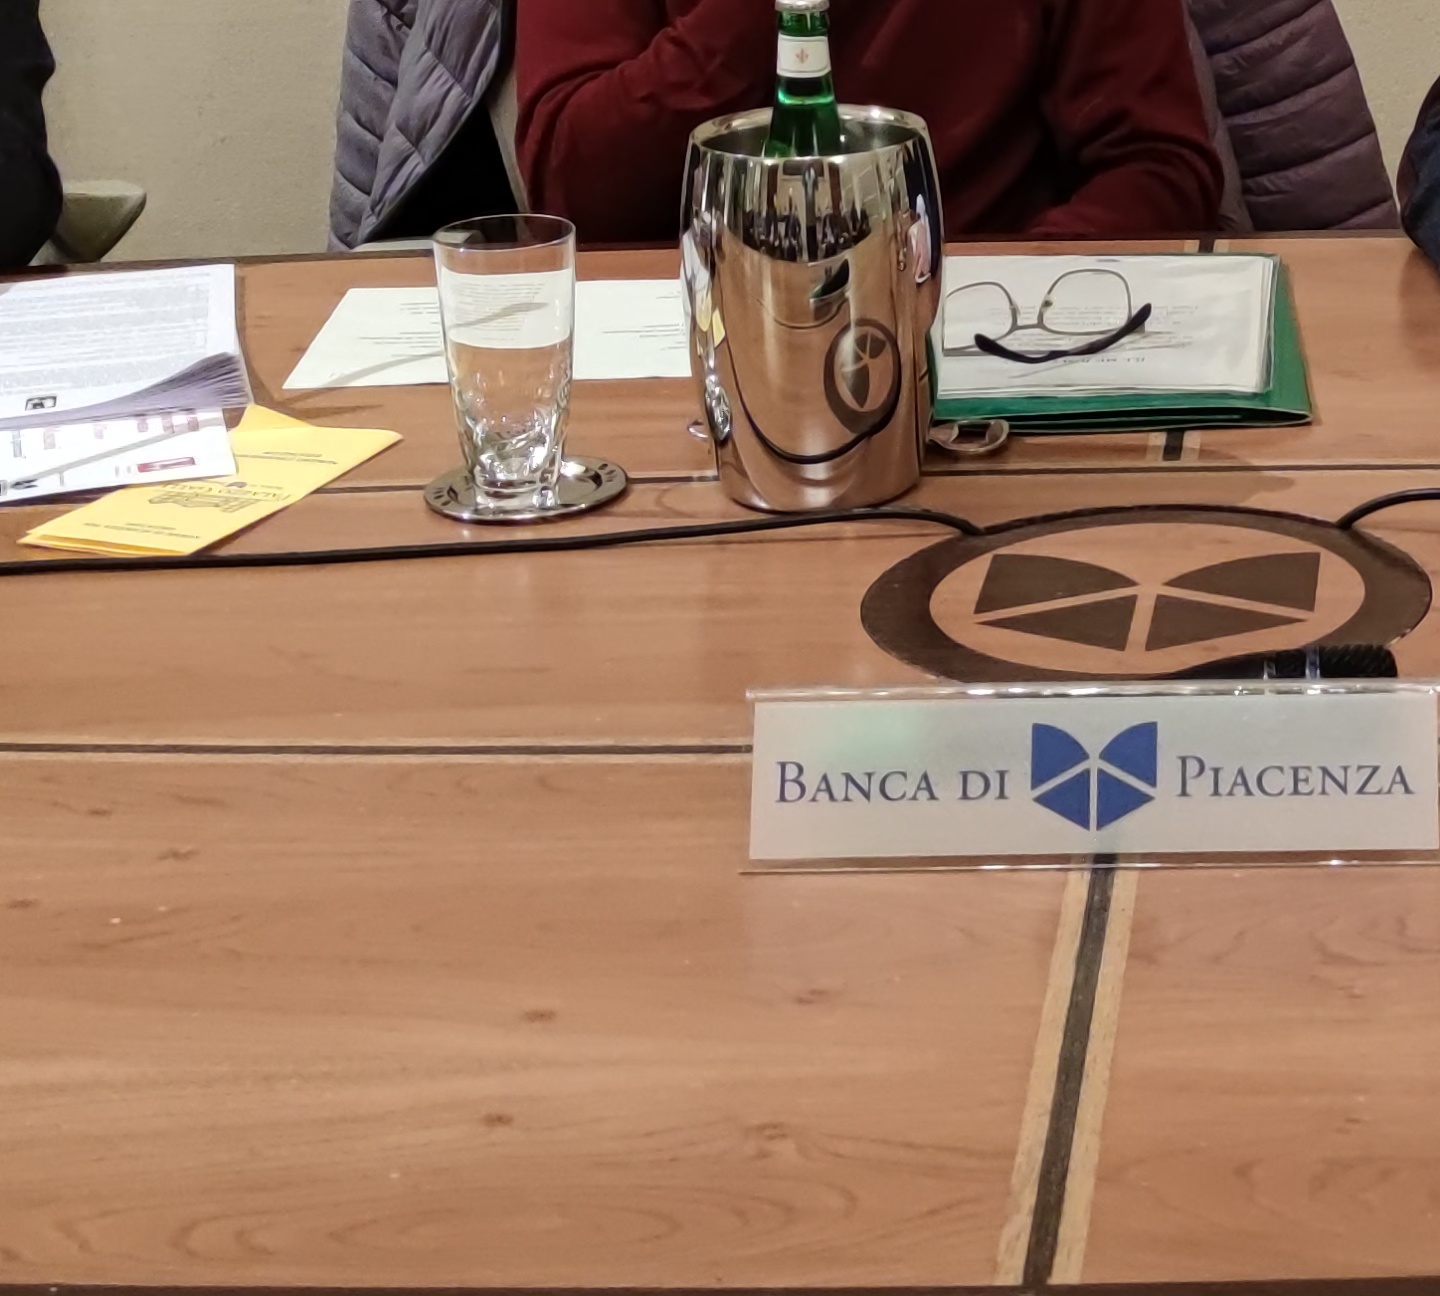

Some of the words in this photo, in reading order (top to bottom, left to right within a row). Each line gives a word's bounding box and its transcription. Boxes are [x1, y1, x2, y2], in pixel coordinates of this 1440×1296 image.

[775, 761, 938, 803] BANCA
[958, 769, 1009, 801] DI
[1176, 755, 1415, 798] PIACENZA
